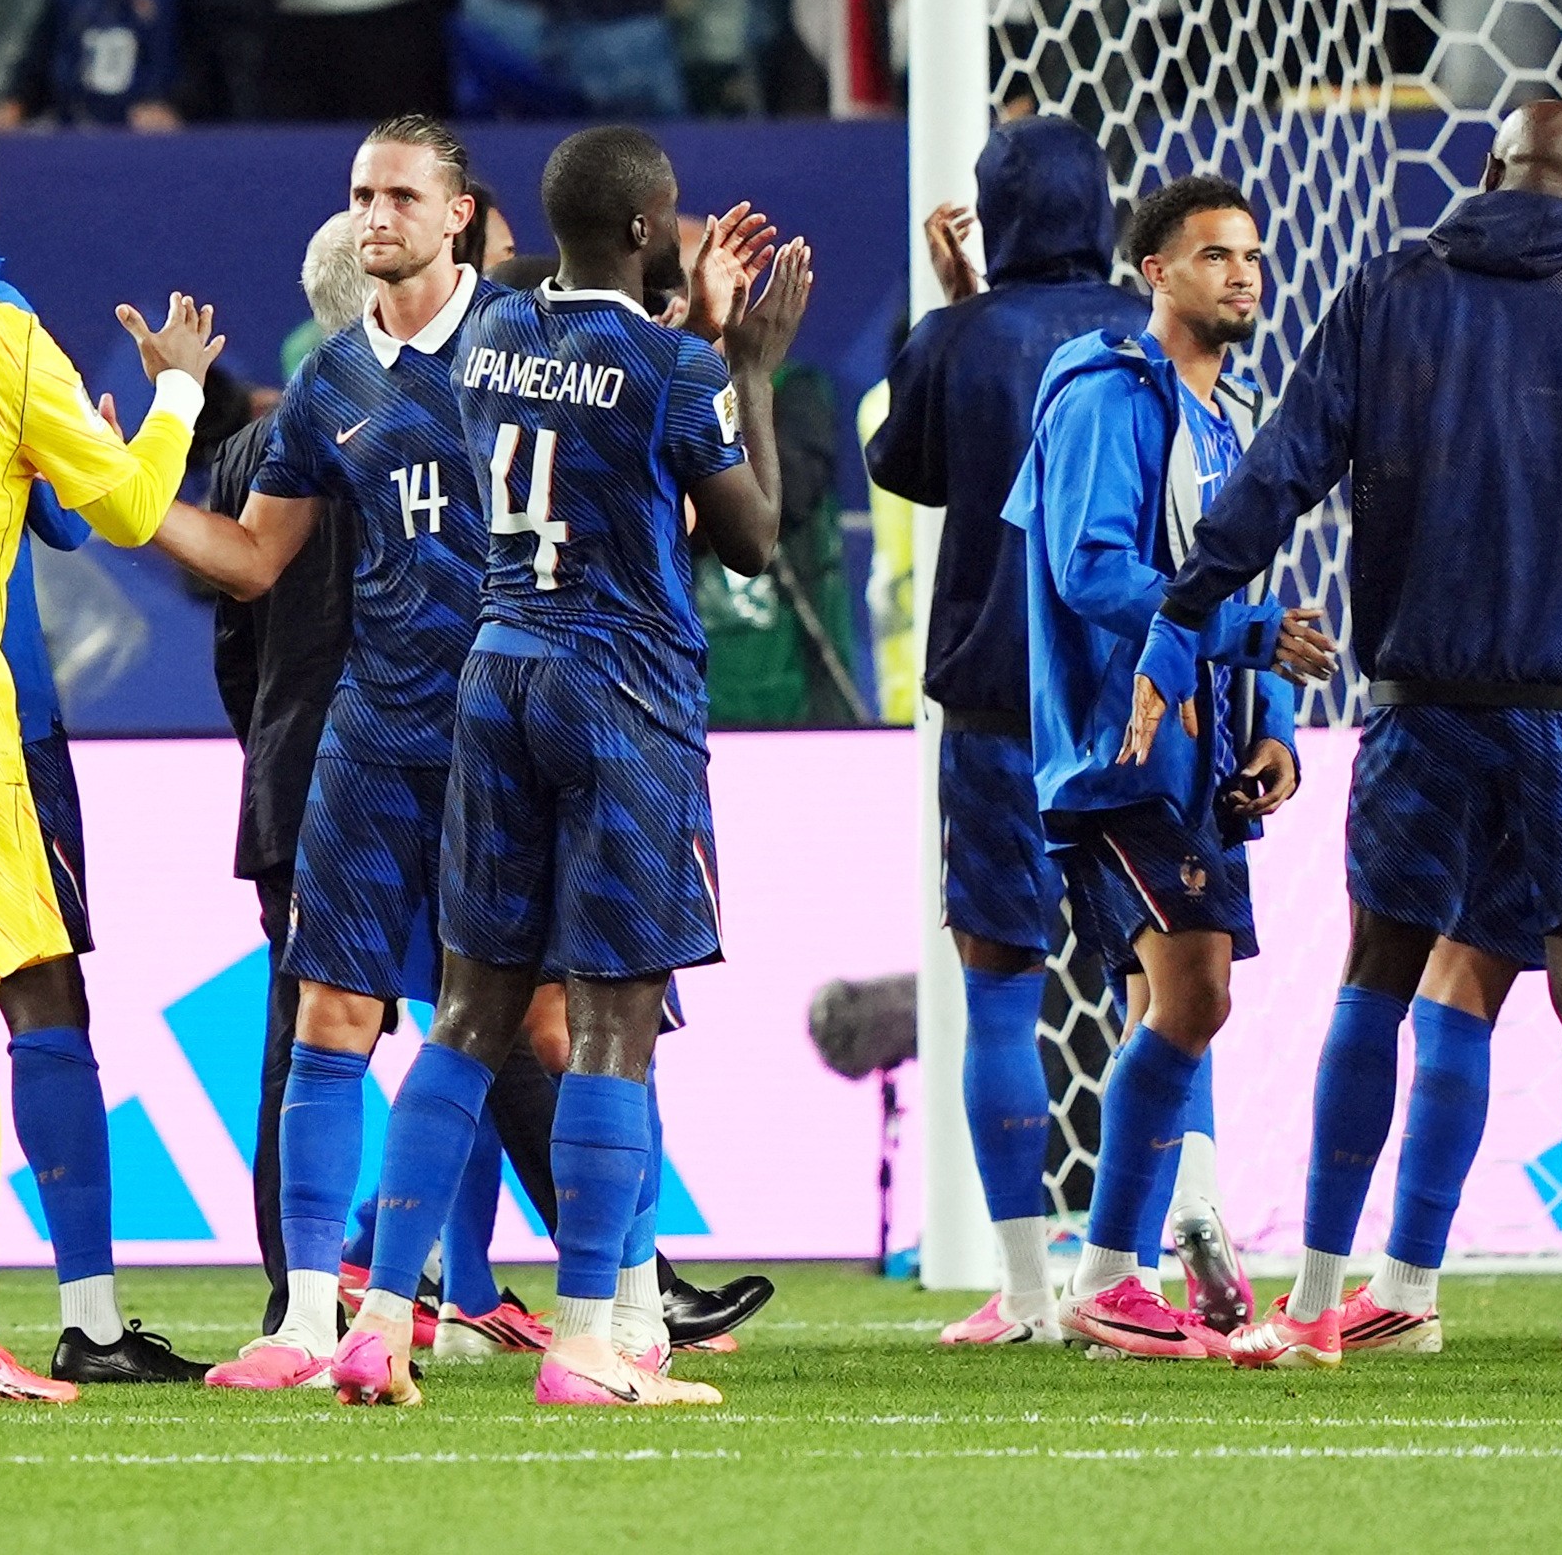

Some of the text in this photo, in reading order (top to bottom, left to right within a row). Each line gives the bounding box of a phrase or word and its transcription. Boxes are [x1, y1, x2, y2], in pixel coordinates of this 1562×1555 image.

[463, 345, 624, 410] UPAMECANO
[389, 460, 449, 540] 14
[490, 422, 569, 591] 4
